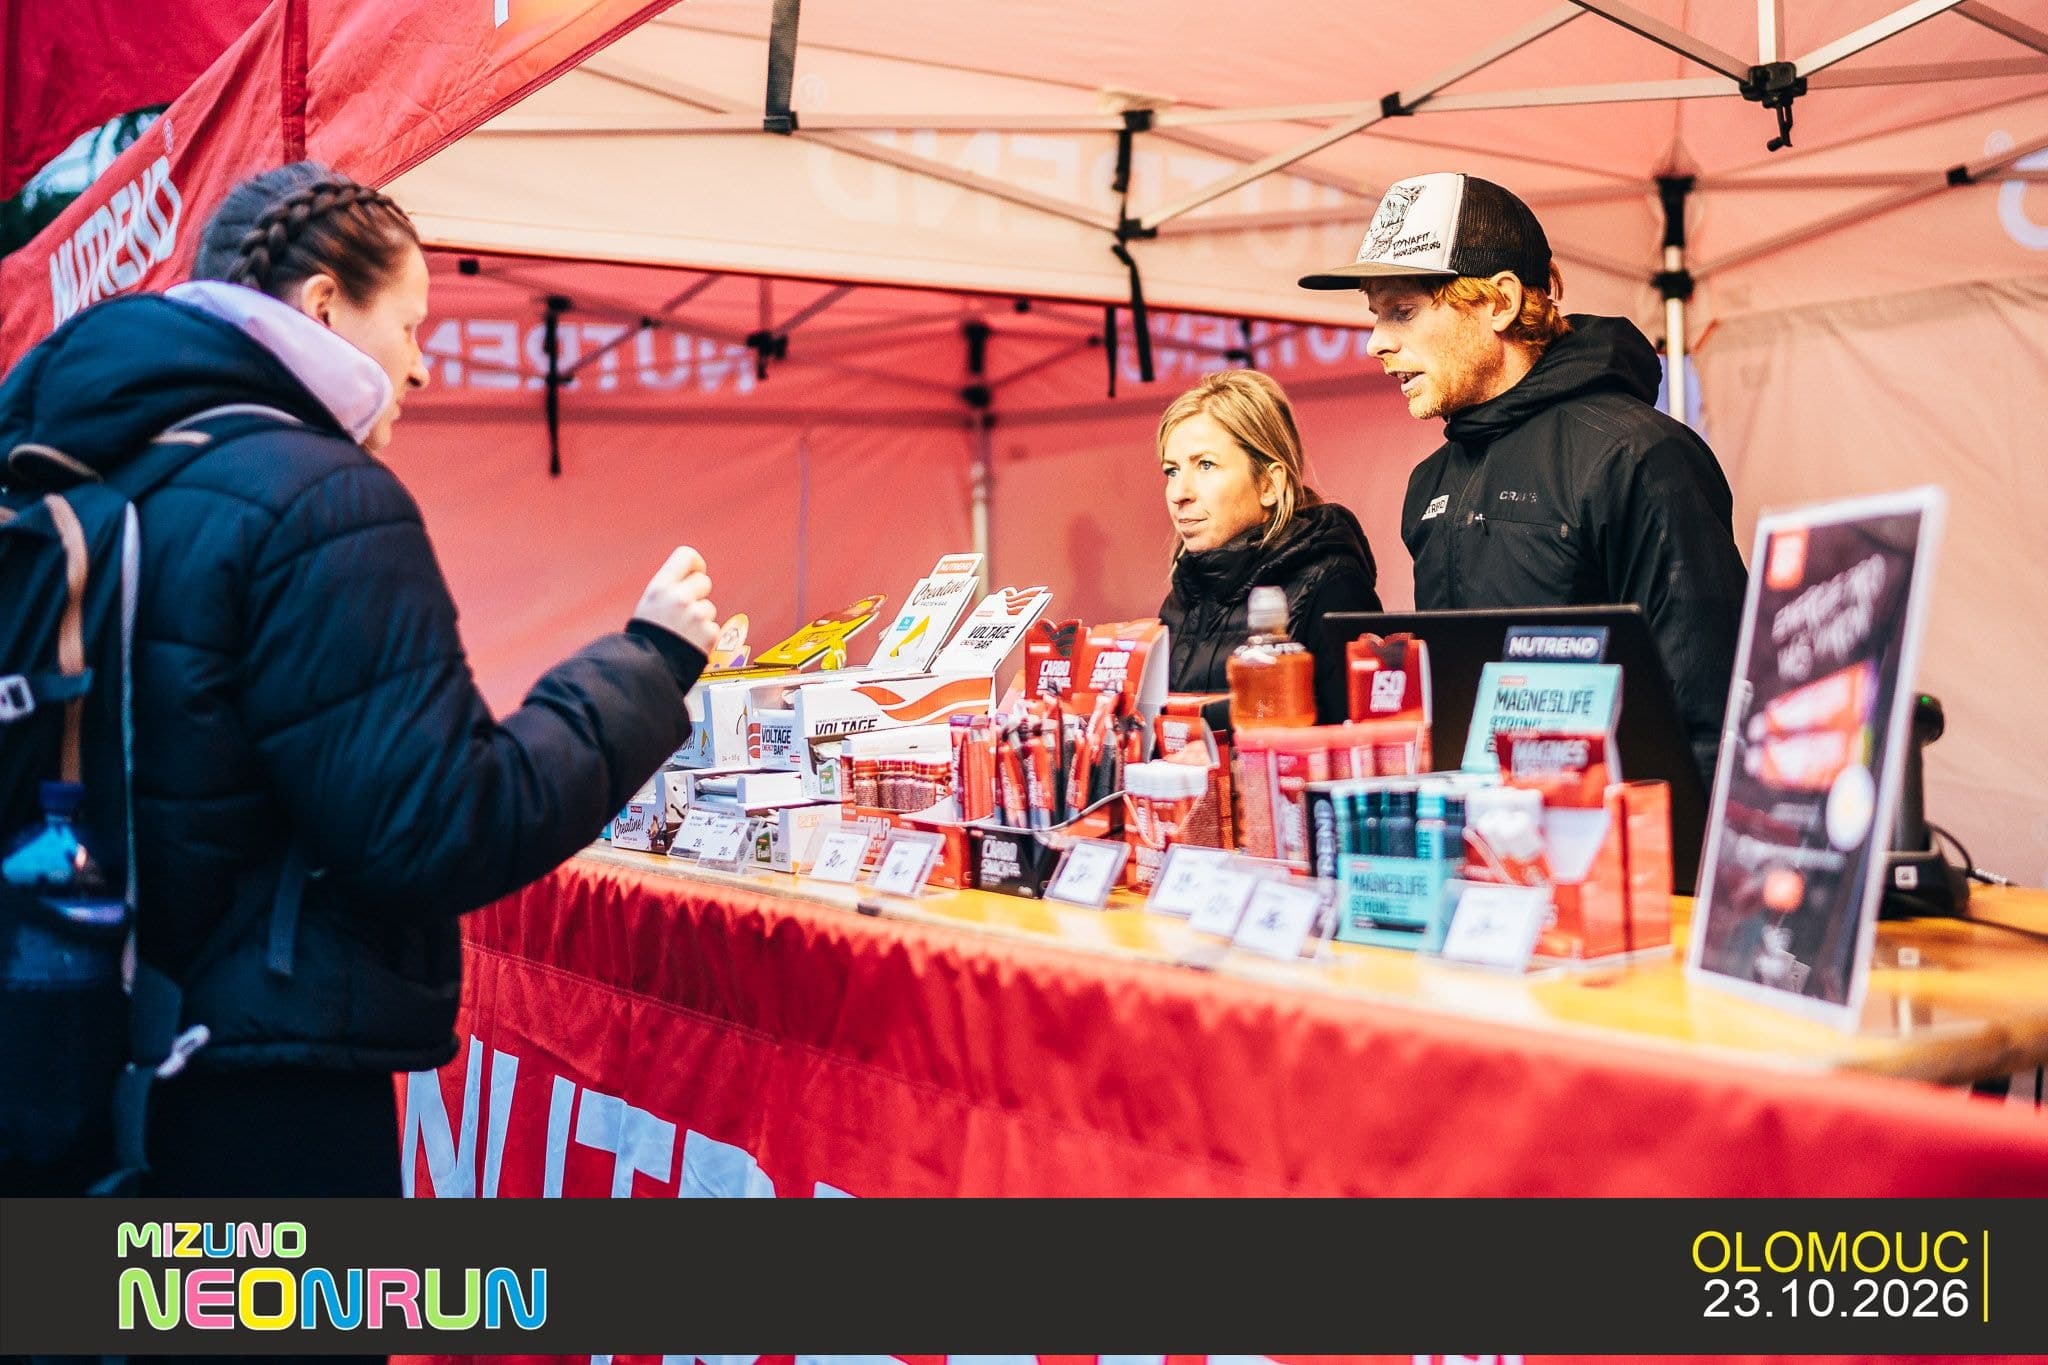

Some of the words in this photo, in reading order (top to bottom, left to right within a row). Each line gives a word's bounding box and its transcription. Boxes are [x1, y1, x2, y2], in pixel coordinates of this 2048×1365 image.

[968, 625, 1016, 639] VOLTAGE
[1508, 636, 1600, 658] NUTREND
[1493, 688, 1594, 715] MAGNESLIFE
[762, 728, 792, 744] VOLTAGE
[774, 745, 784, 755] BAR
[614, 811, 645, 839] Creatine!
